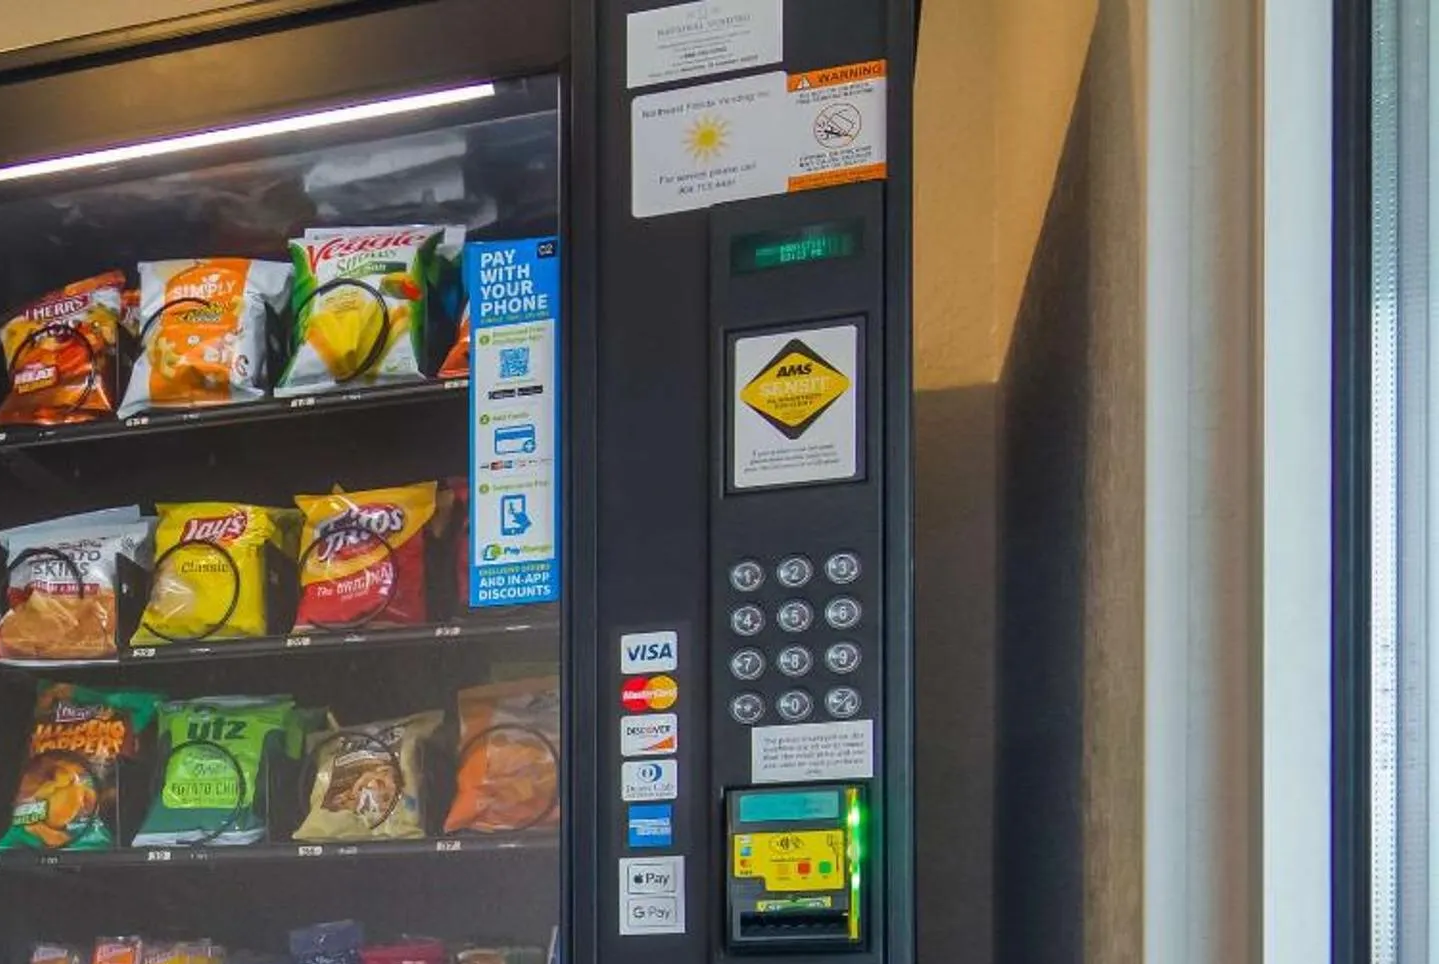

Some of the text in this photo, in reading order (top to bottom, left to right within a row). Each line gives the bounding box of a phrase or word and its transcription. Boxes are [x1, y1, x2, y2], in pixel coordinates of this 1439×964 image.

[819, 66, 882, 83] WARNING
[307, 230, 425, 274] Veggie
[481, 248, 516, 268] PAY
[480, 264, 531, 285] WITH
[480, 280, 534, 302] YOUR
[480, 294, 549, 318] PHONE
[777, 363, 812, 378] AMS
[185, 517, 247, 541] Lay's
[181, 559, 229, 574] Classic
[480, 574, 505, 588] AND
[479, 585, 551, 601] DISCOUNTS
[627, 643, 672, 661] VISA
[646, 873, 669, 886] Pay
[633, 906, 671, 920] G Pay
